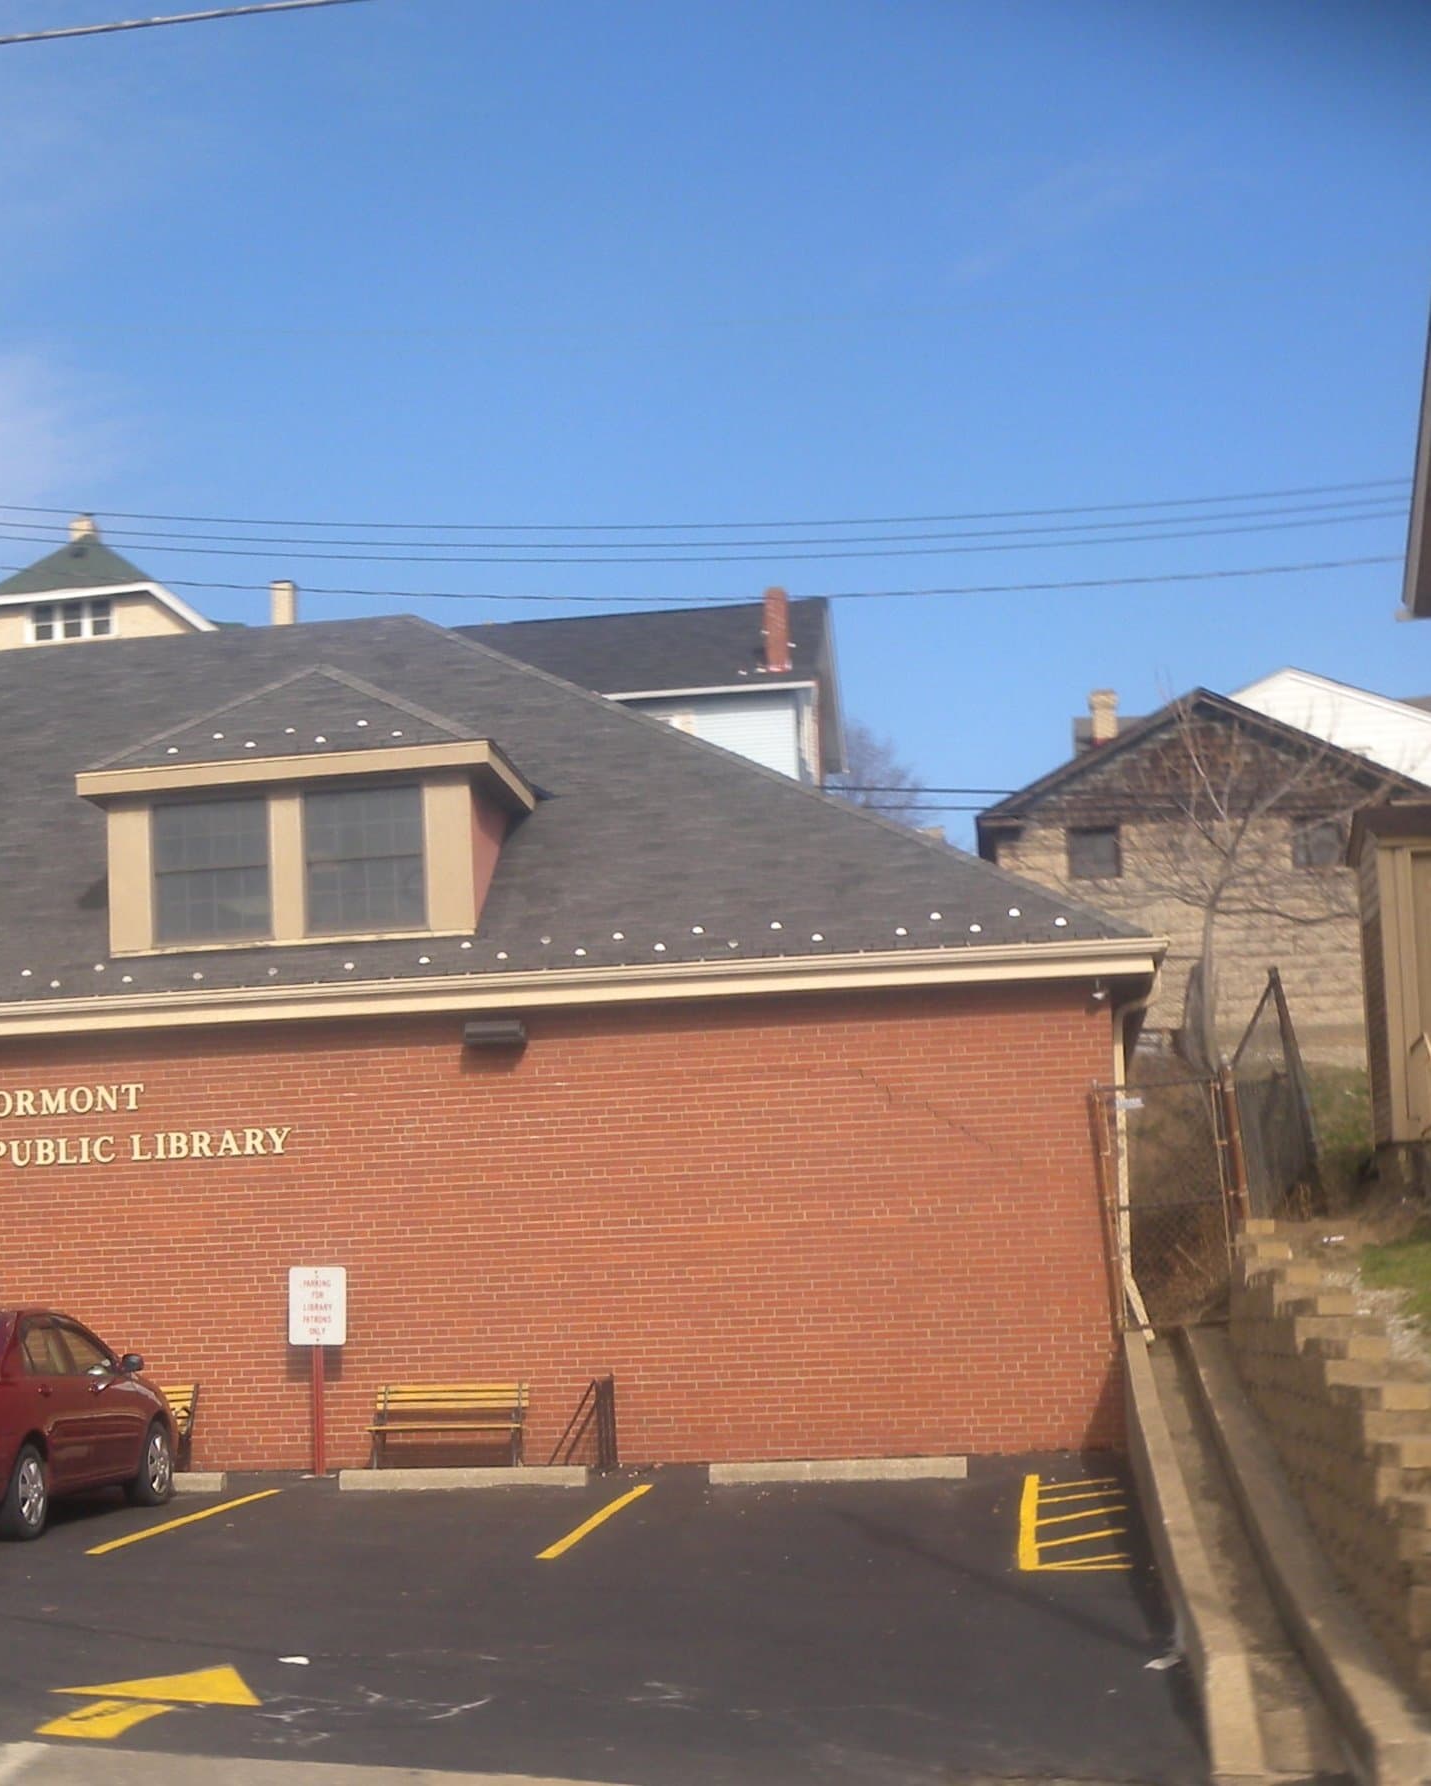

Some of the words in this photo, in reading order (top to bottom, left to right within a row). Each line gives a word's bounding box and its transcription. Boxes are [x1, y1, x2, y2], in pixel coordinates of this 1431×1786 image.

[130, 1127, 292, 1160] LIBRARY
[302, 1279, 331, 1288] PARKING
[302, 1303, 333, 1312] LIBRARY
[302, 1315, 332, 1324] PATRONS
[309, 1327, 326, 1336] ONLY
